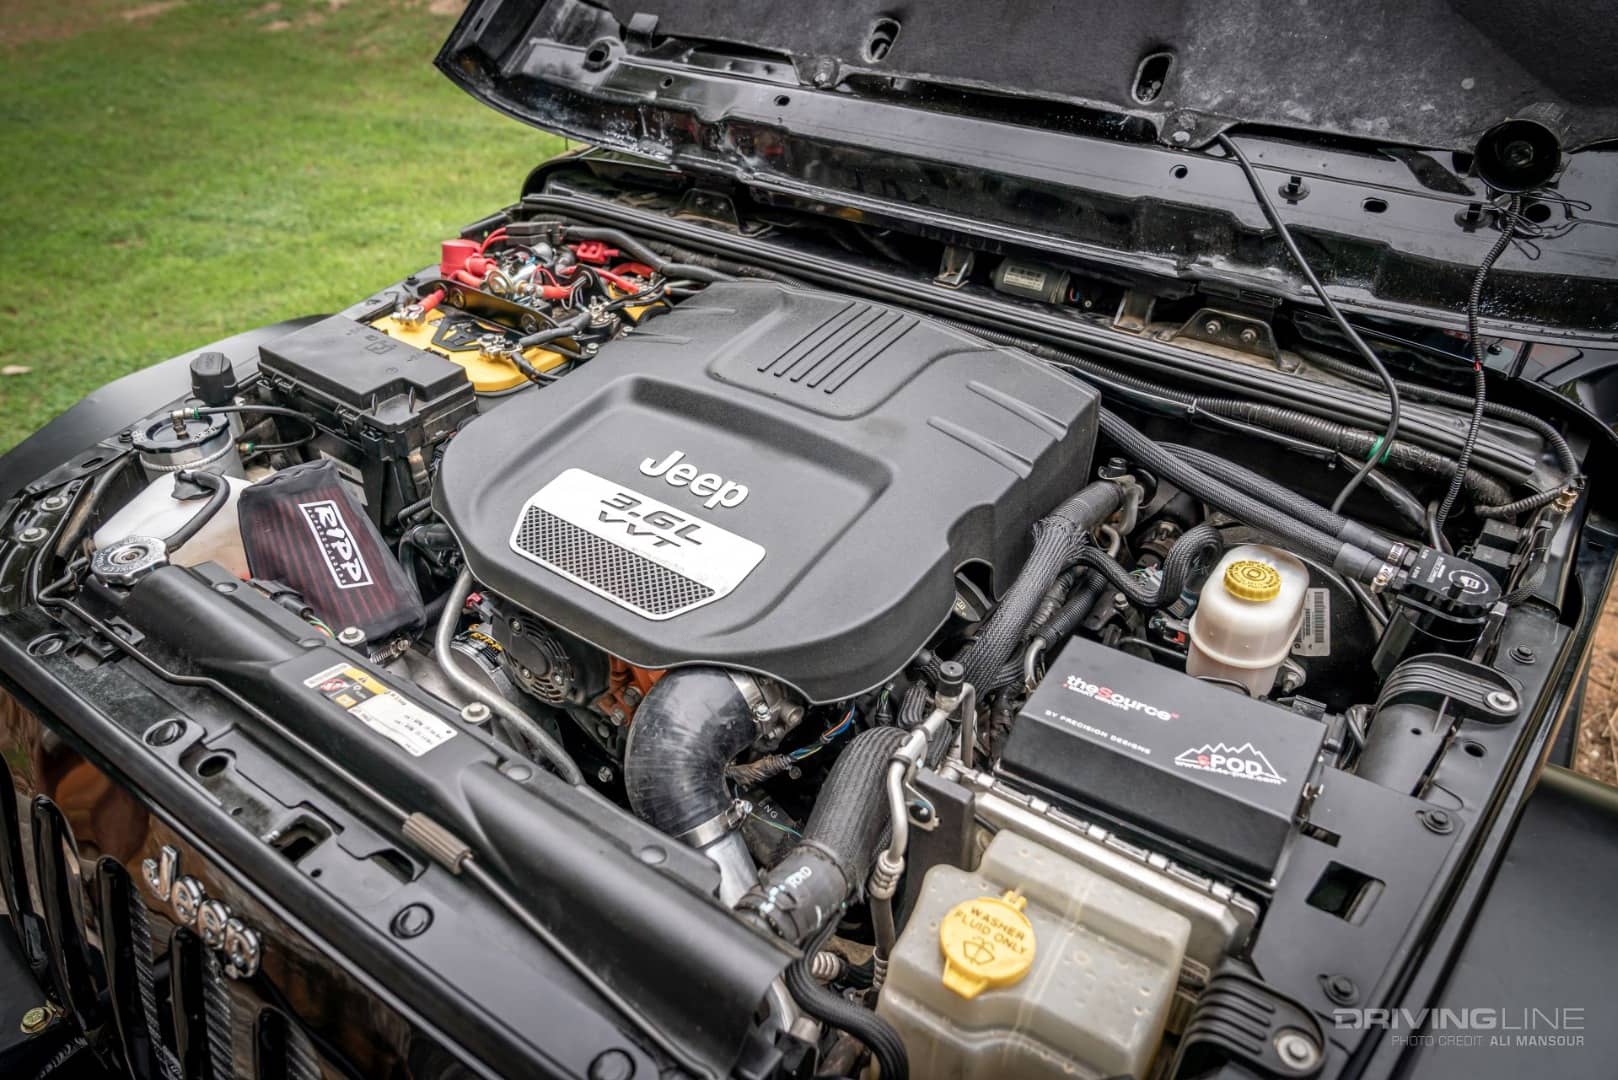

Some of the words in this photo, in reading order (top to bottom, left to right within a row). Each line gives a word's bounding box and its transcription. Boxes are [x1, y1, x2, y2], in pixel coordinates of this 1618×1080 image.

[639, 450, 749, 510] Jeep
[598, 510, 682, 548] VVT
[600, 492, 703, 545] 3.6L
[314, 505, 362, 582] RIPP
[1067, 675, 1171, 721] theSource
[1045, 709, 1058, 718] BY
[1060, 715, 1108, 738] PRECISION
[1110, 735, 1151, 754] DESIGNS
[142, 844, 261, 979] Jeep
[954, 908, 991, 936] FLUID
[994, 933, 1028, 954] ONLY
[971, 906, 1025, 941] WASHER
